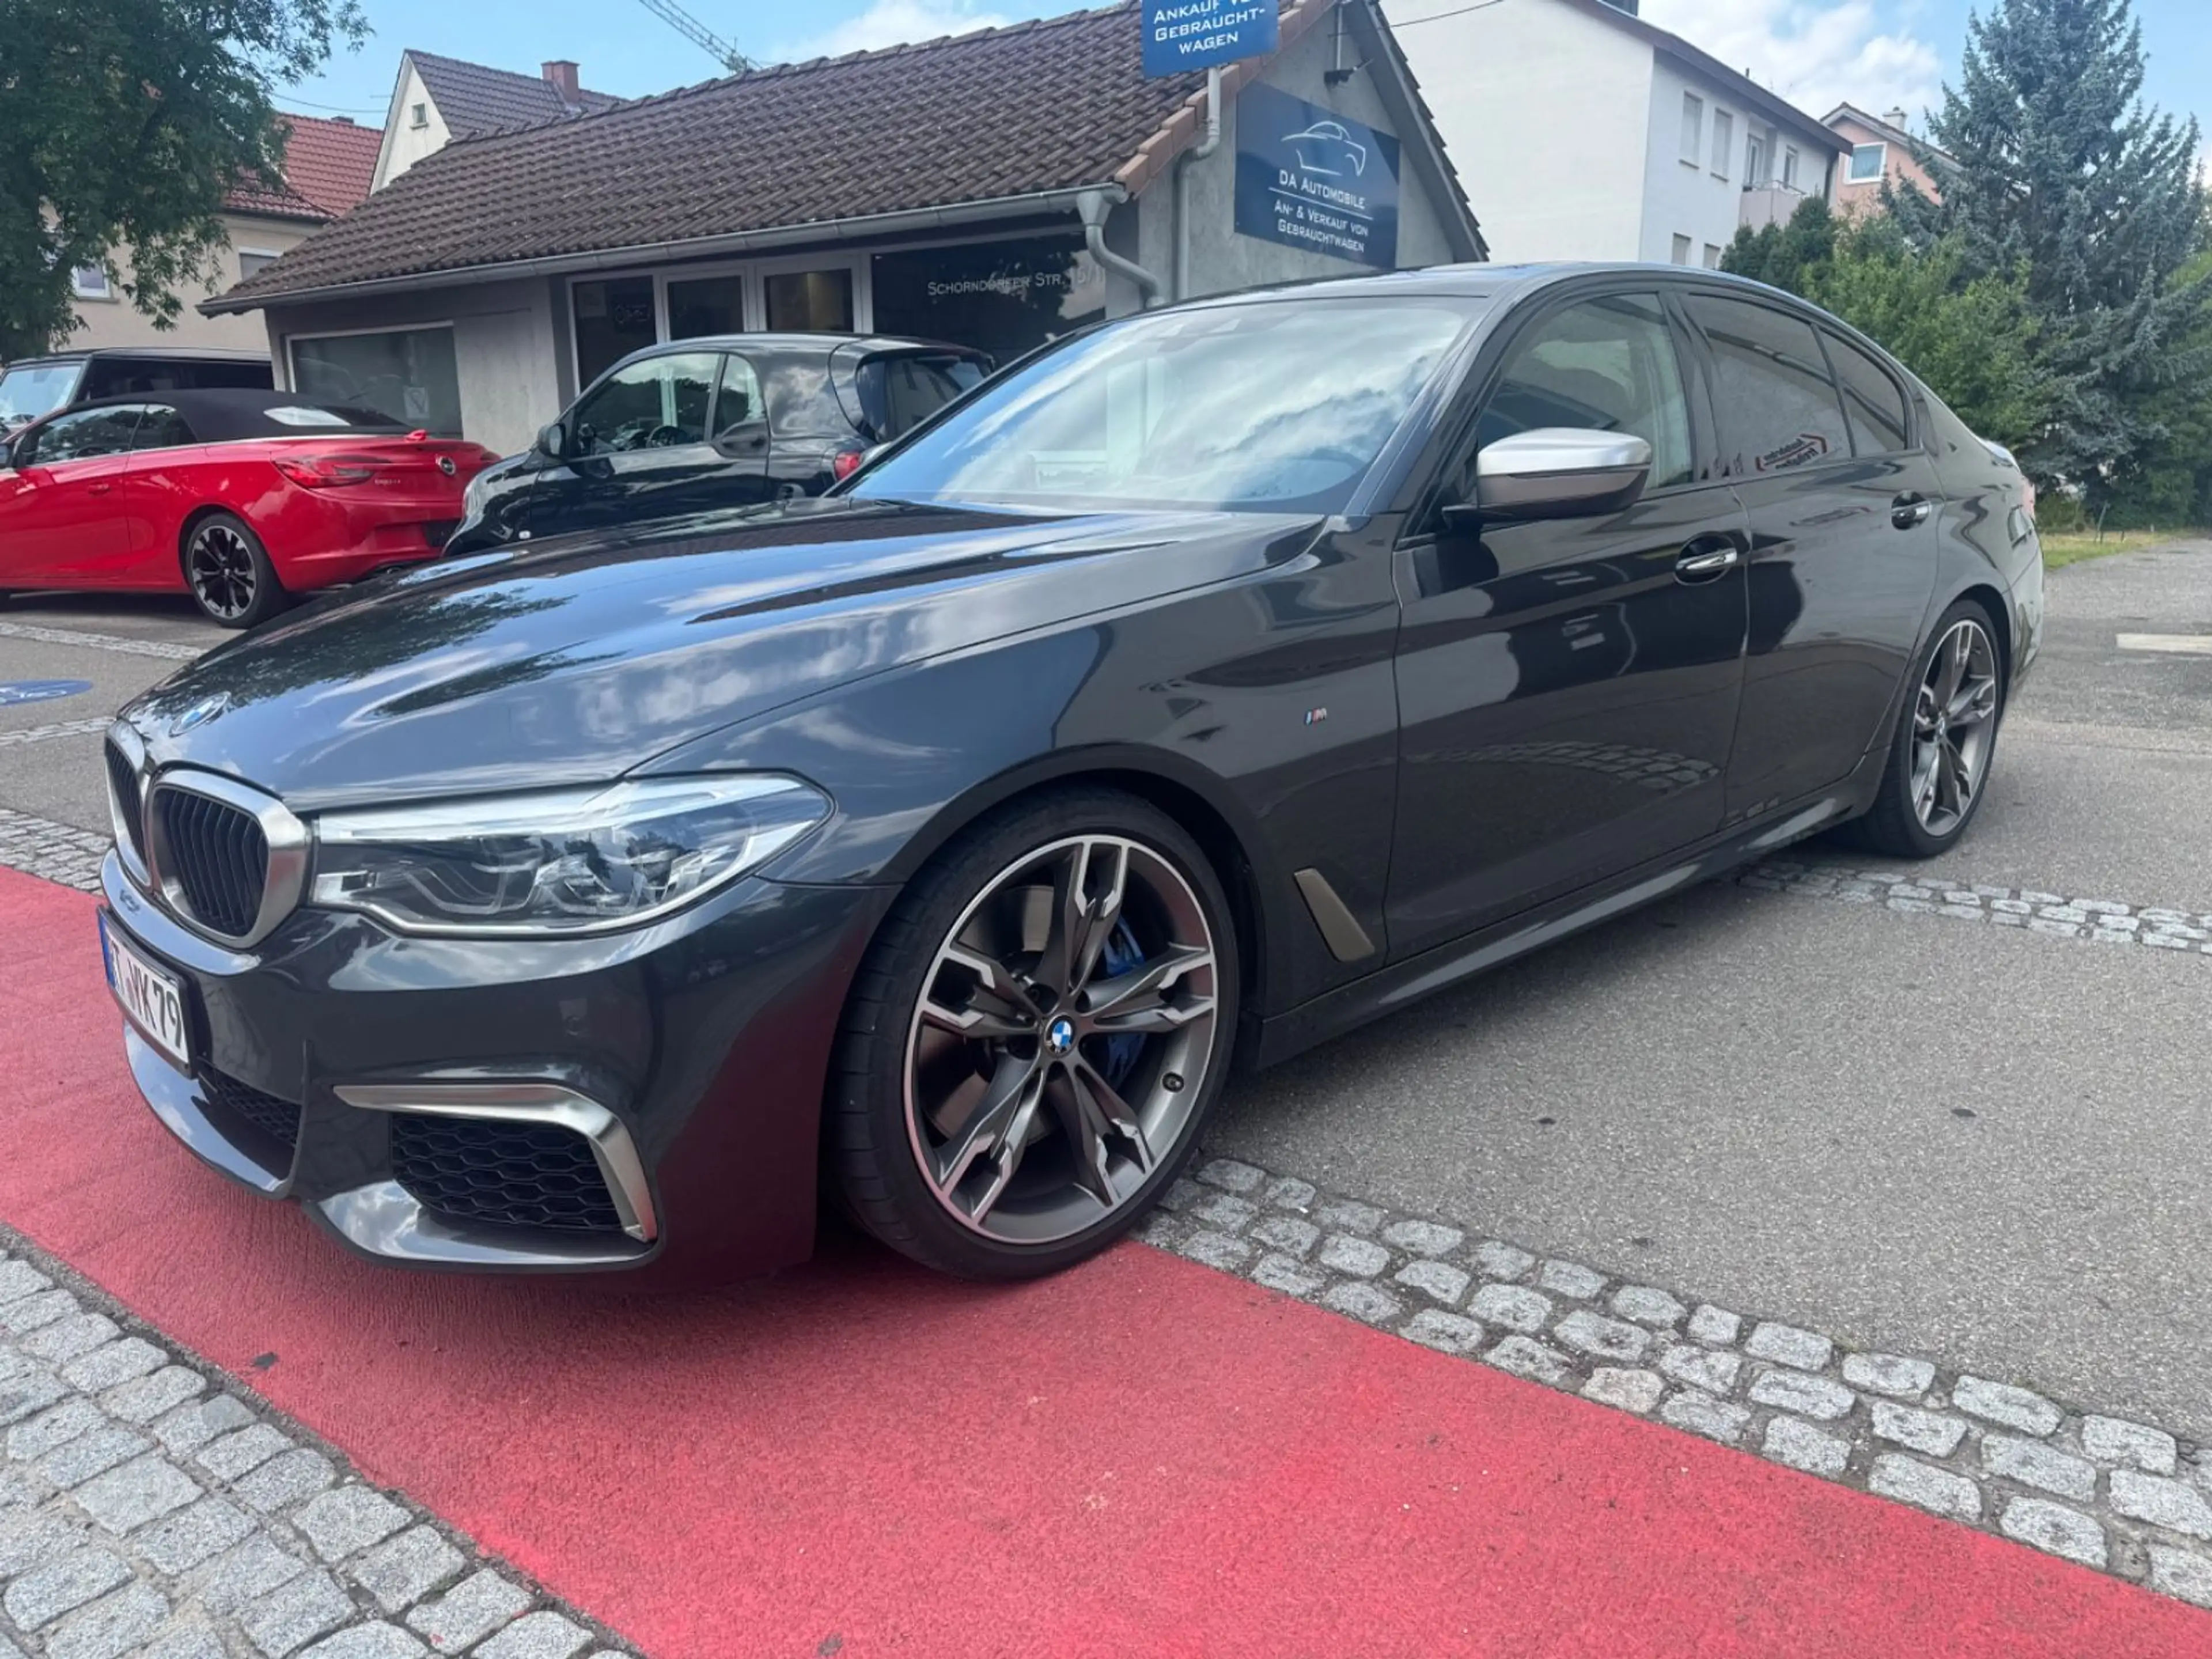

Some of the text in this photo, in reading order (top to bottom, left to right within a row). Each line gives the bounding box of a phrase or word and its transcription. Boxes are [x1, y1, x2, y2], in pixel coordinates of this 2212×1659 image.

[1155, 7, 1266, 41] GEBRAUCHT-
[1179, 31, 1238, 55] WAGEN
[1279, 169, 1366, 210] DA AUTOMOBILE
[1274, 199, 1369, 237] AN- & VERKAUF VON
[1278, 218, 1365, 253] GEBRAUCHTWAGEN
[1035, 272, 1065, 287] STR.
